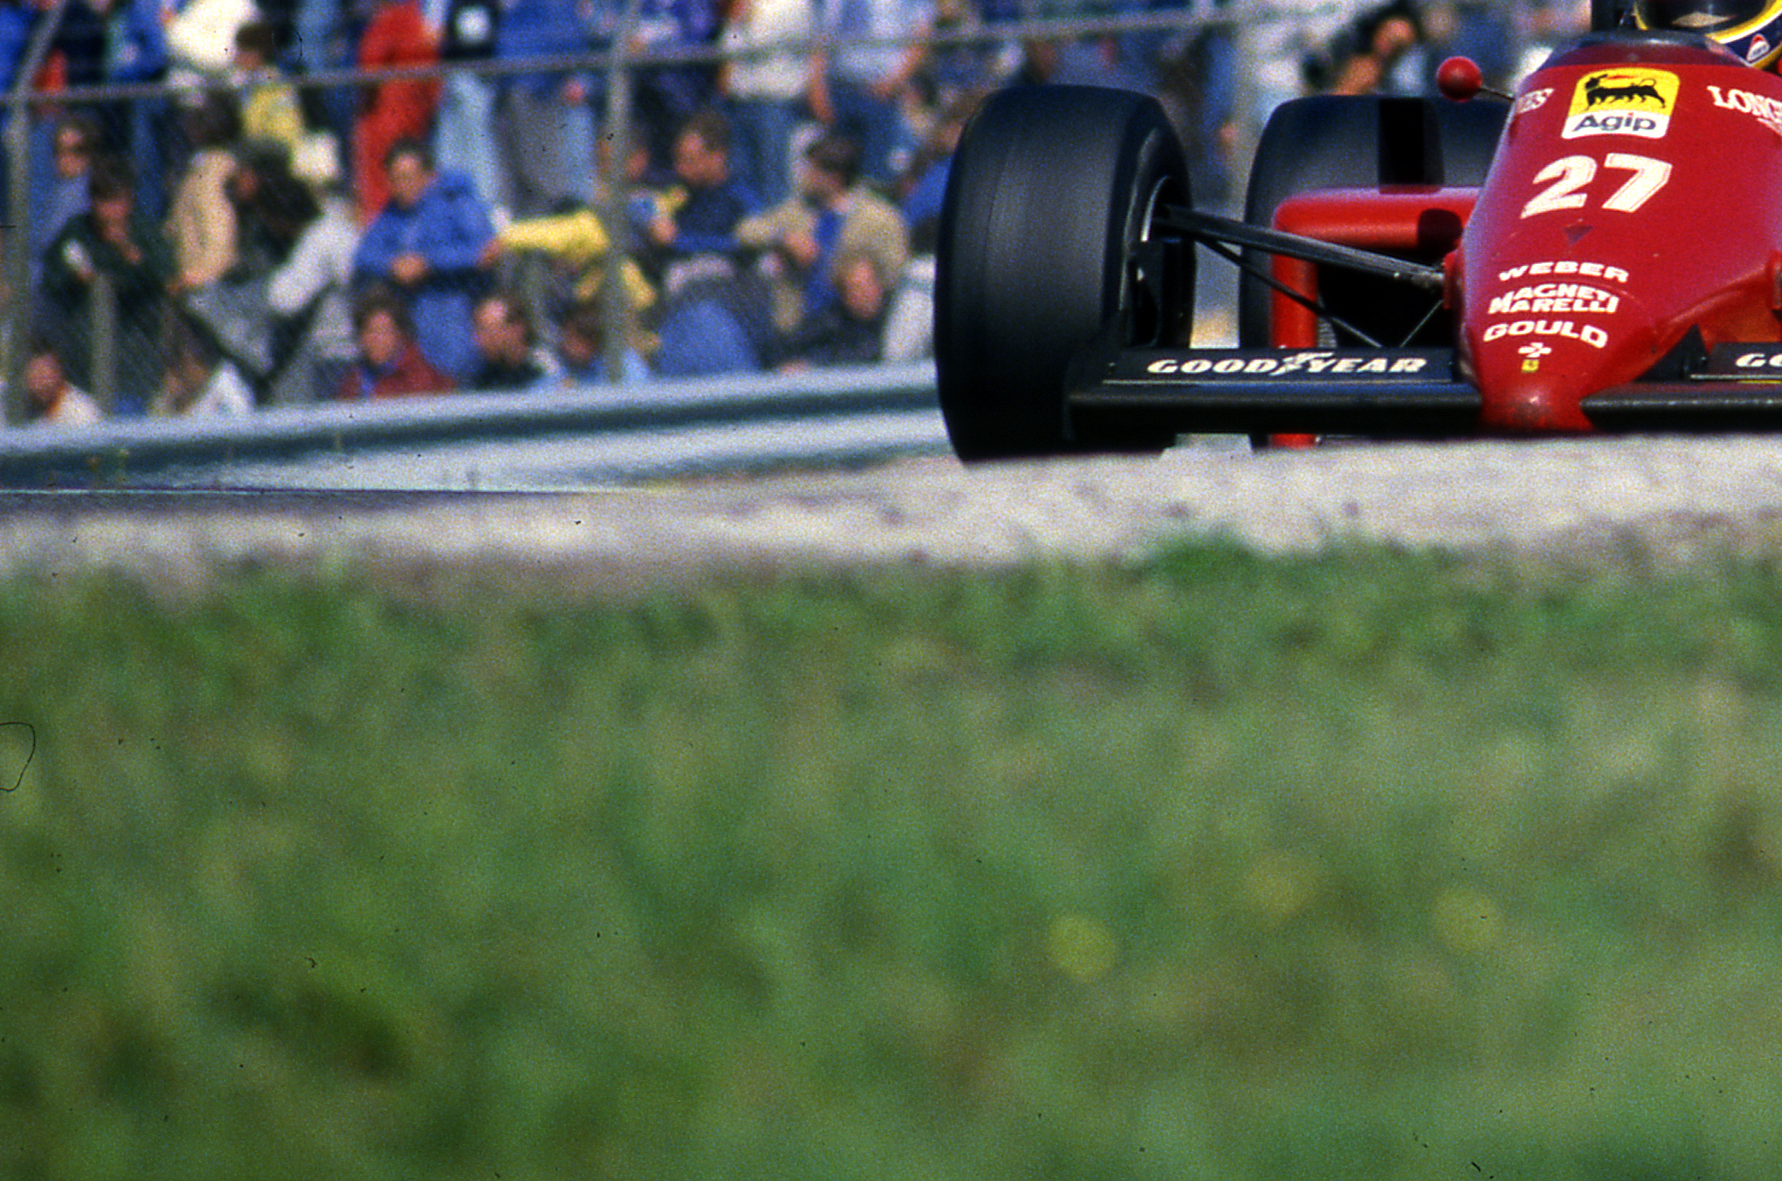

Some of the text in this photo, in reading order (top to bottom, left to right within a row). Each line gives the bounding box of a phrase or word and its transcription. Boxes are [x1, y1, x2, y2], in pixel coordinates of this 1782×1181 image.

[1573, 112, 1657, 133] Agip
[1520, 152, 1673, 219] 27
[1499, 261, 1629, 283] WEBER
[1488, 296, 1619, 314] MARELLI
[1483, 320, 1609, 348] GOULD
